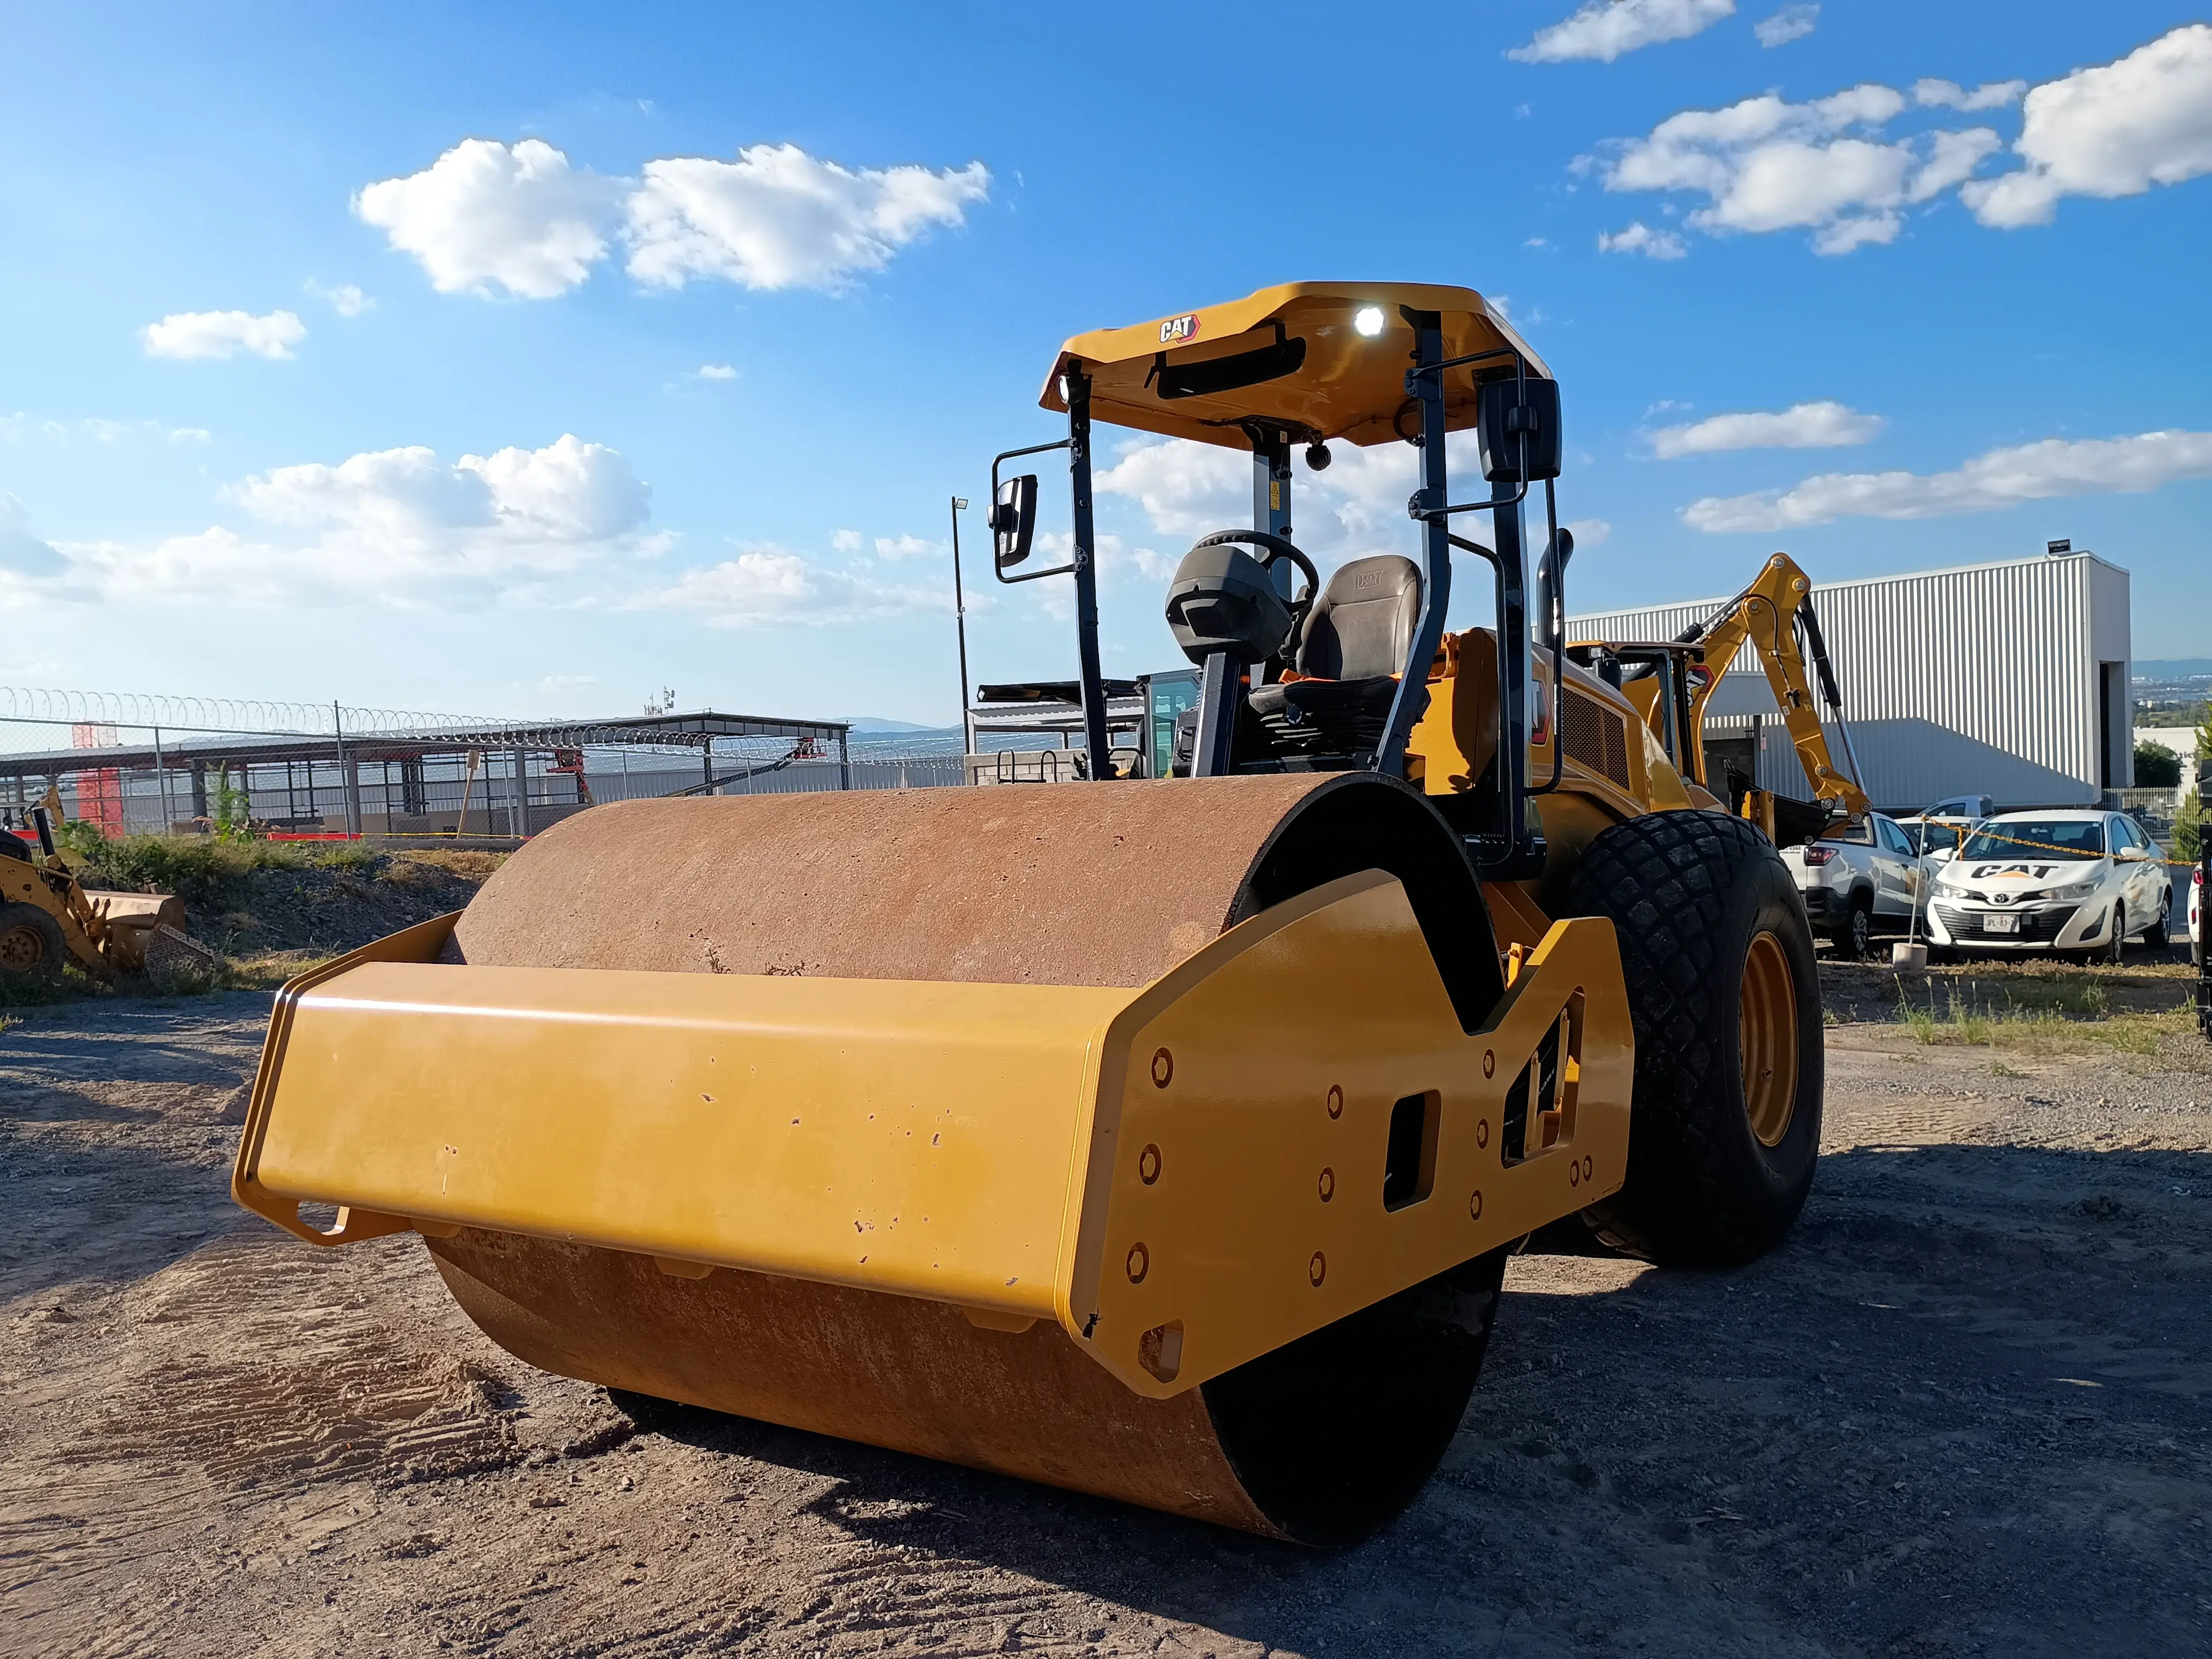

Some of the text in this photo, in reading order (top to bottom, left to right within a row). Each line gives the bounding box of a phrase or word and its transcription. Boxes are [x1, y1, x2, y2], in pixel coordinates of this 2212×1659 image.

[1160, 316, 1192, 342] CAT
[1357, 570, 1384, 589] CAT
[1971, 865, 2059, 879] CAT
